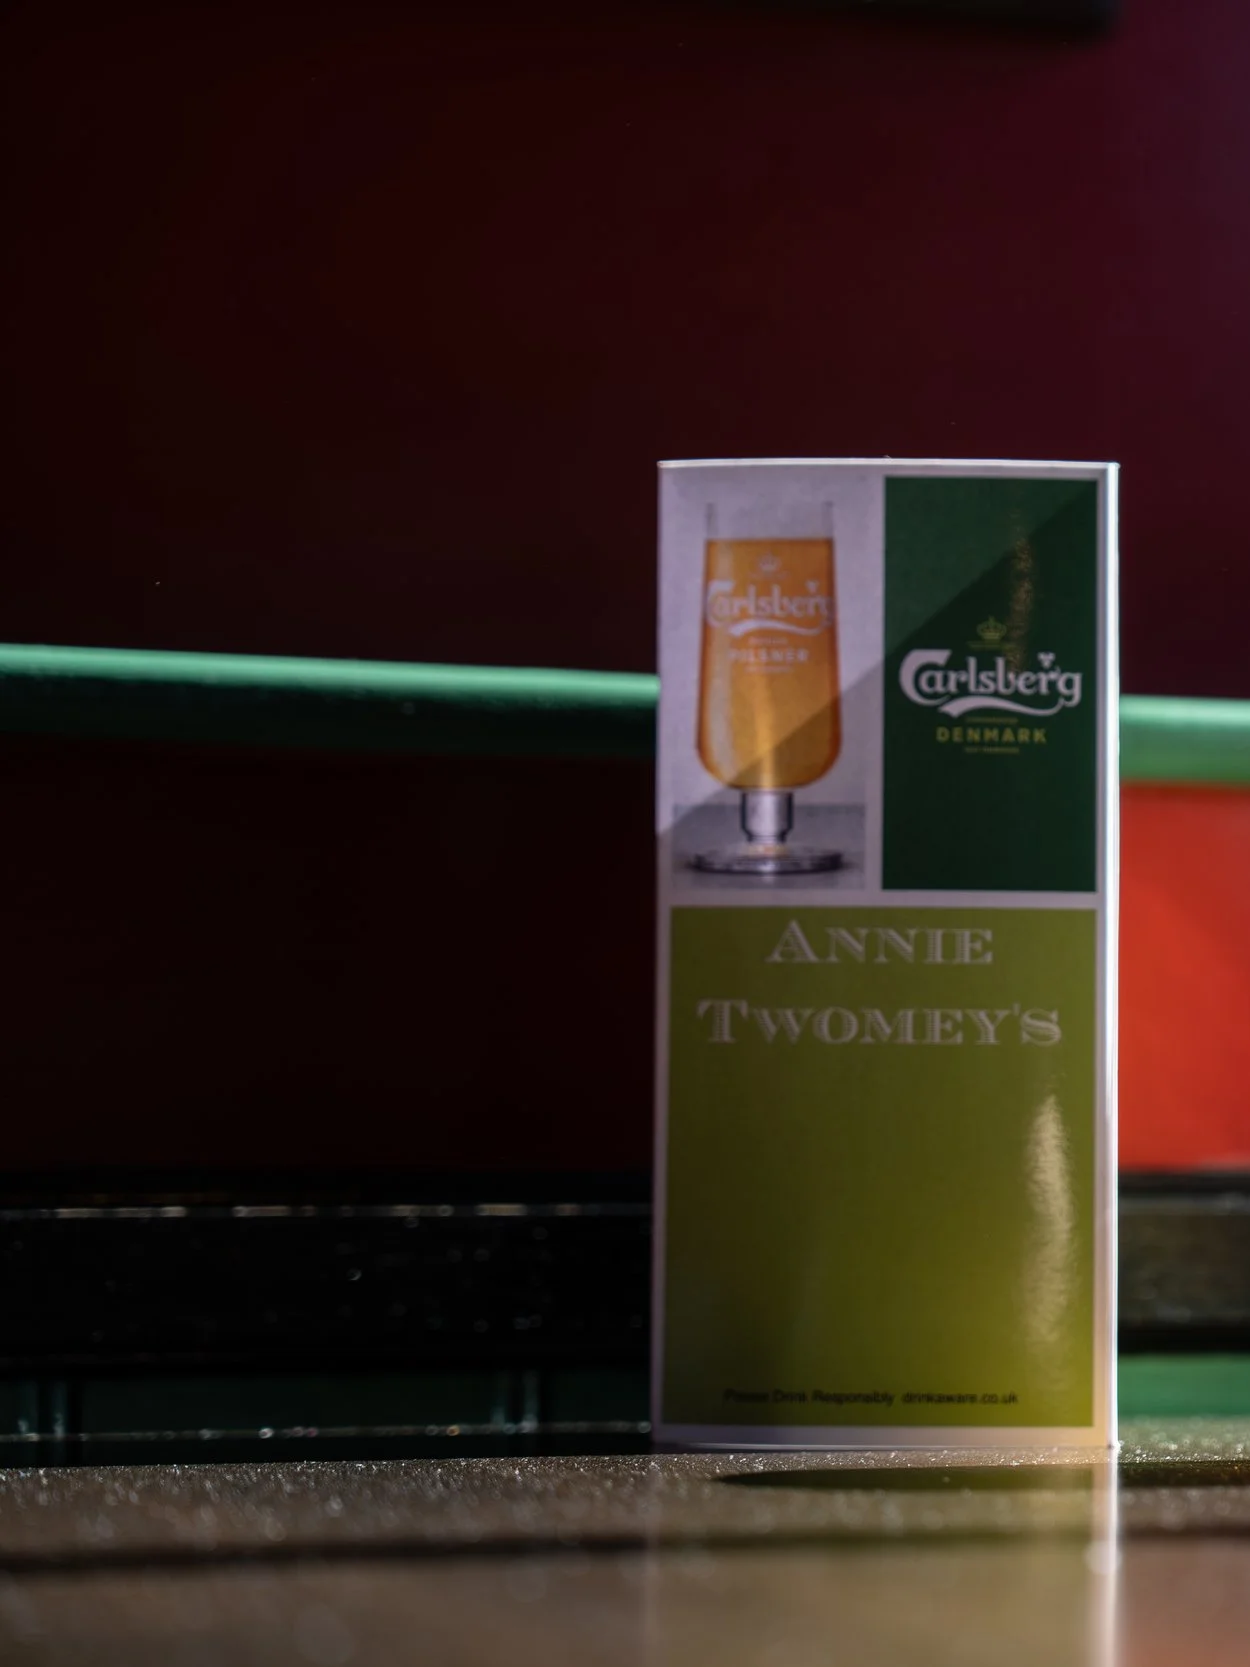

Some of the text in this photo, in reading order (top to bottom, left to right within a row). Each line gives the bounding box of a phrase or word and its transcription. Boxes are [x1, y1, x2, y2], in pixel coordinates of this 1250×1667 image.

[899, 649, 1082, 708] Carlsberg
[936, 727, 1046, 743] DENMARK
[765, 919, 993, 964] ANNIE
[696, 999, 1062, 1046] TWOMEY'S
